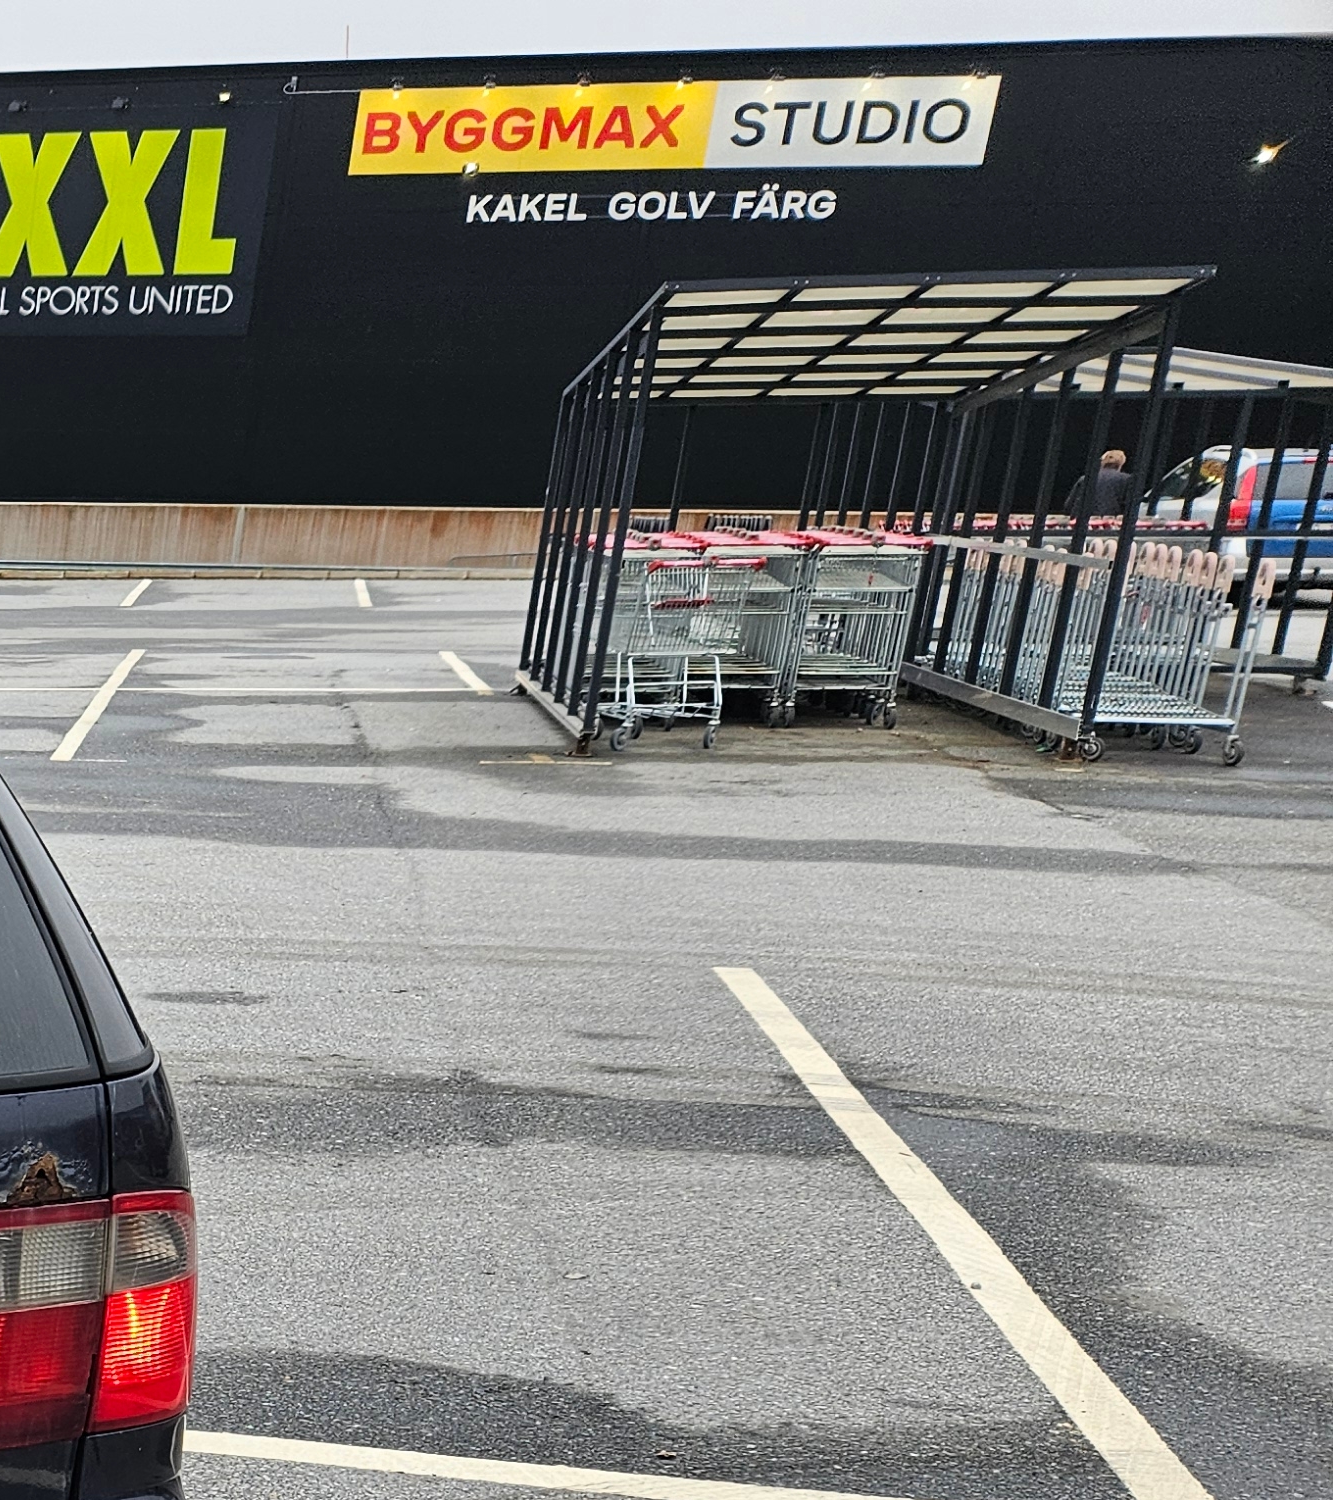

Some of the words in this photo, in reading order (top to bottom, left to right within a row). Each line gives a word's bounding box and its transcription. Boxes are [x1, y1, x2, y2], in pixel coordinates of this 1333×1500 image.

[361, 104, 685, 155] BYGGMAX
[730, 98, 971, 147] STUDIO
[466, 192, 587, 223] KAKEL
[607, 190, 715, 221] GOLV
[732, 183, 837, 220] FÄRG
[18, 285, 120, 317] SPORTS
[128, 284, 234, 316] UNITED
